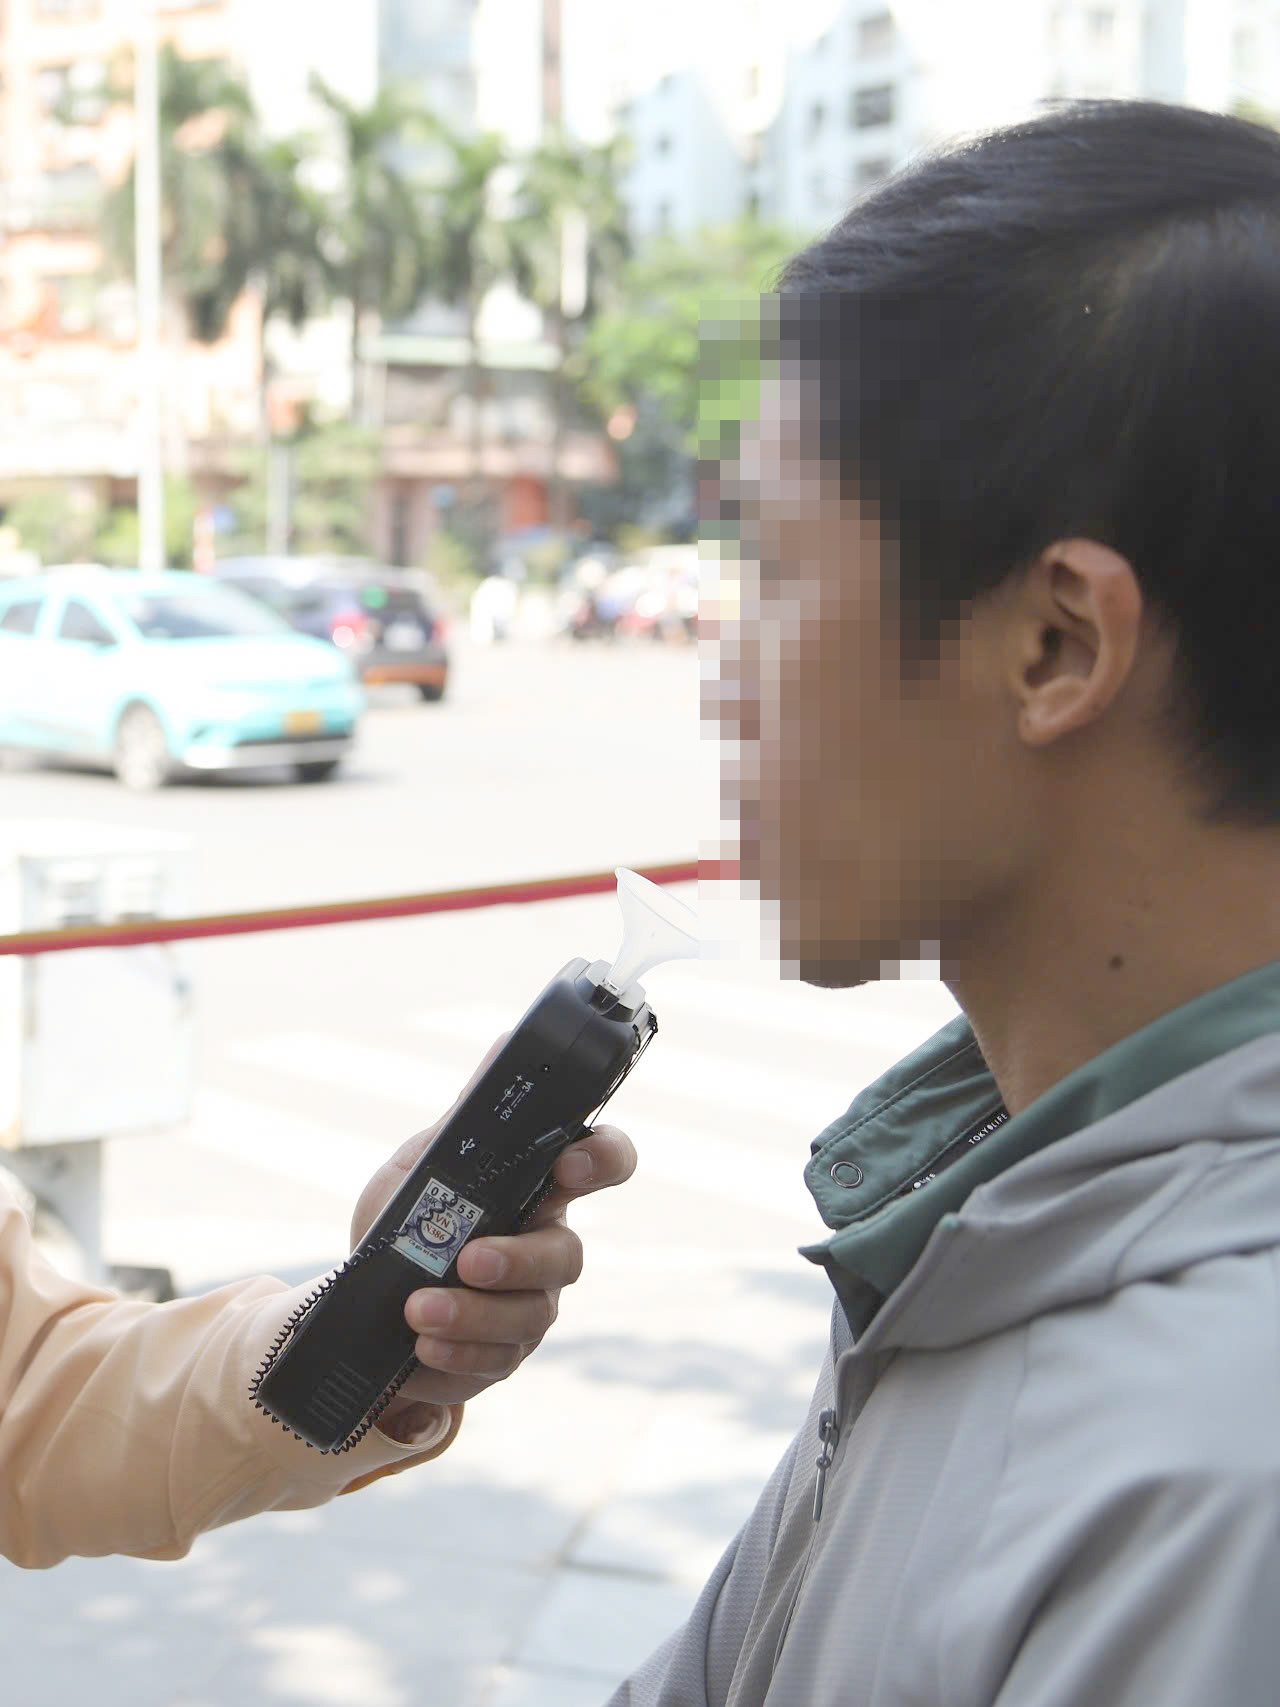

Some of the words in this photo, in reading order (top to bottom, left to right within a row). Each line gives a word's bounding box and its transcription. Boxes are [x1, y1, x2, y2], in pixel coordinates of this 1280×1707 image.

[500, 1106, 512, 1120] 12V
[522, 1082, 534, 1092] 3A
[968, 1112, 1008, 1145] TOKYOLIFE
[430, 1186, 476, 1220] 0555
[423, 1223, 445, 1241] N386
[435, 1214, 450, 1228] VN
